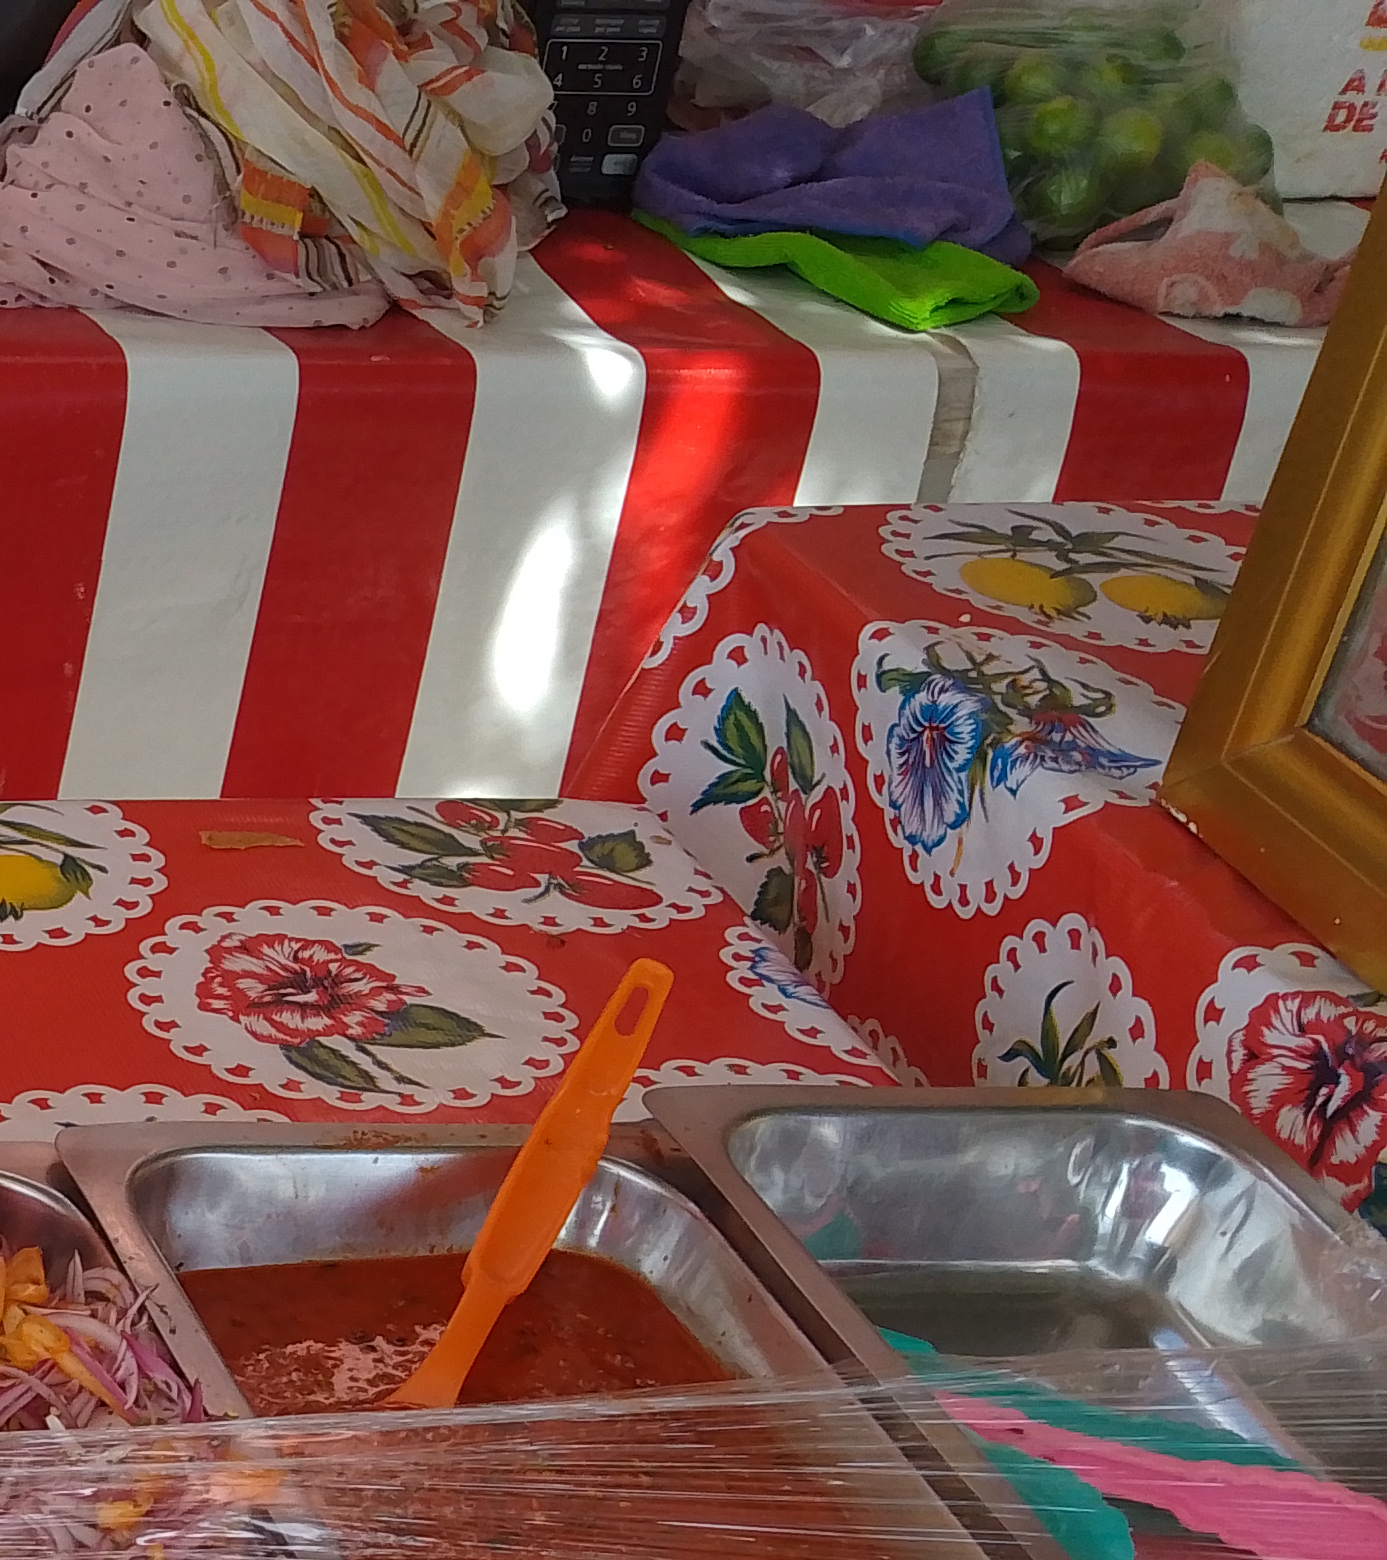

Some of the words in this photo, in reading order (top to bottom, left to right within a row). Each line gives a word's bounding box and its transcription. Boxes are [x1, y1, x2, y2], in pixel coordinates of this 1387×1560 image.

[561, 46, 568, 60] 1
[598, 46, 608, 61] 2
[638, 47, 648, 62] 3
[553, 73, 563, 88] 4
[593, 74, 603, 88] 5
[632, 75, 643, 88] 6
[587, 101, 597, 115] 8
[627, 102, 636, 116] 9
